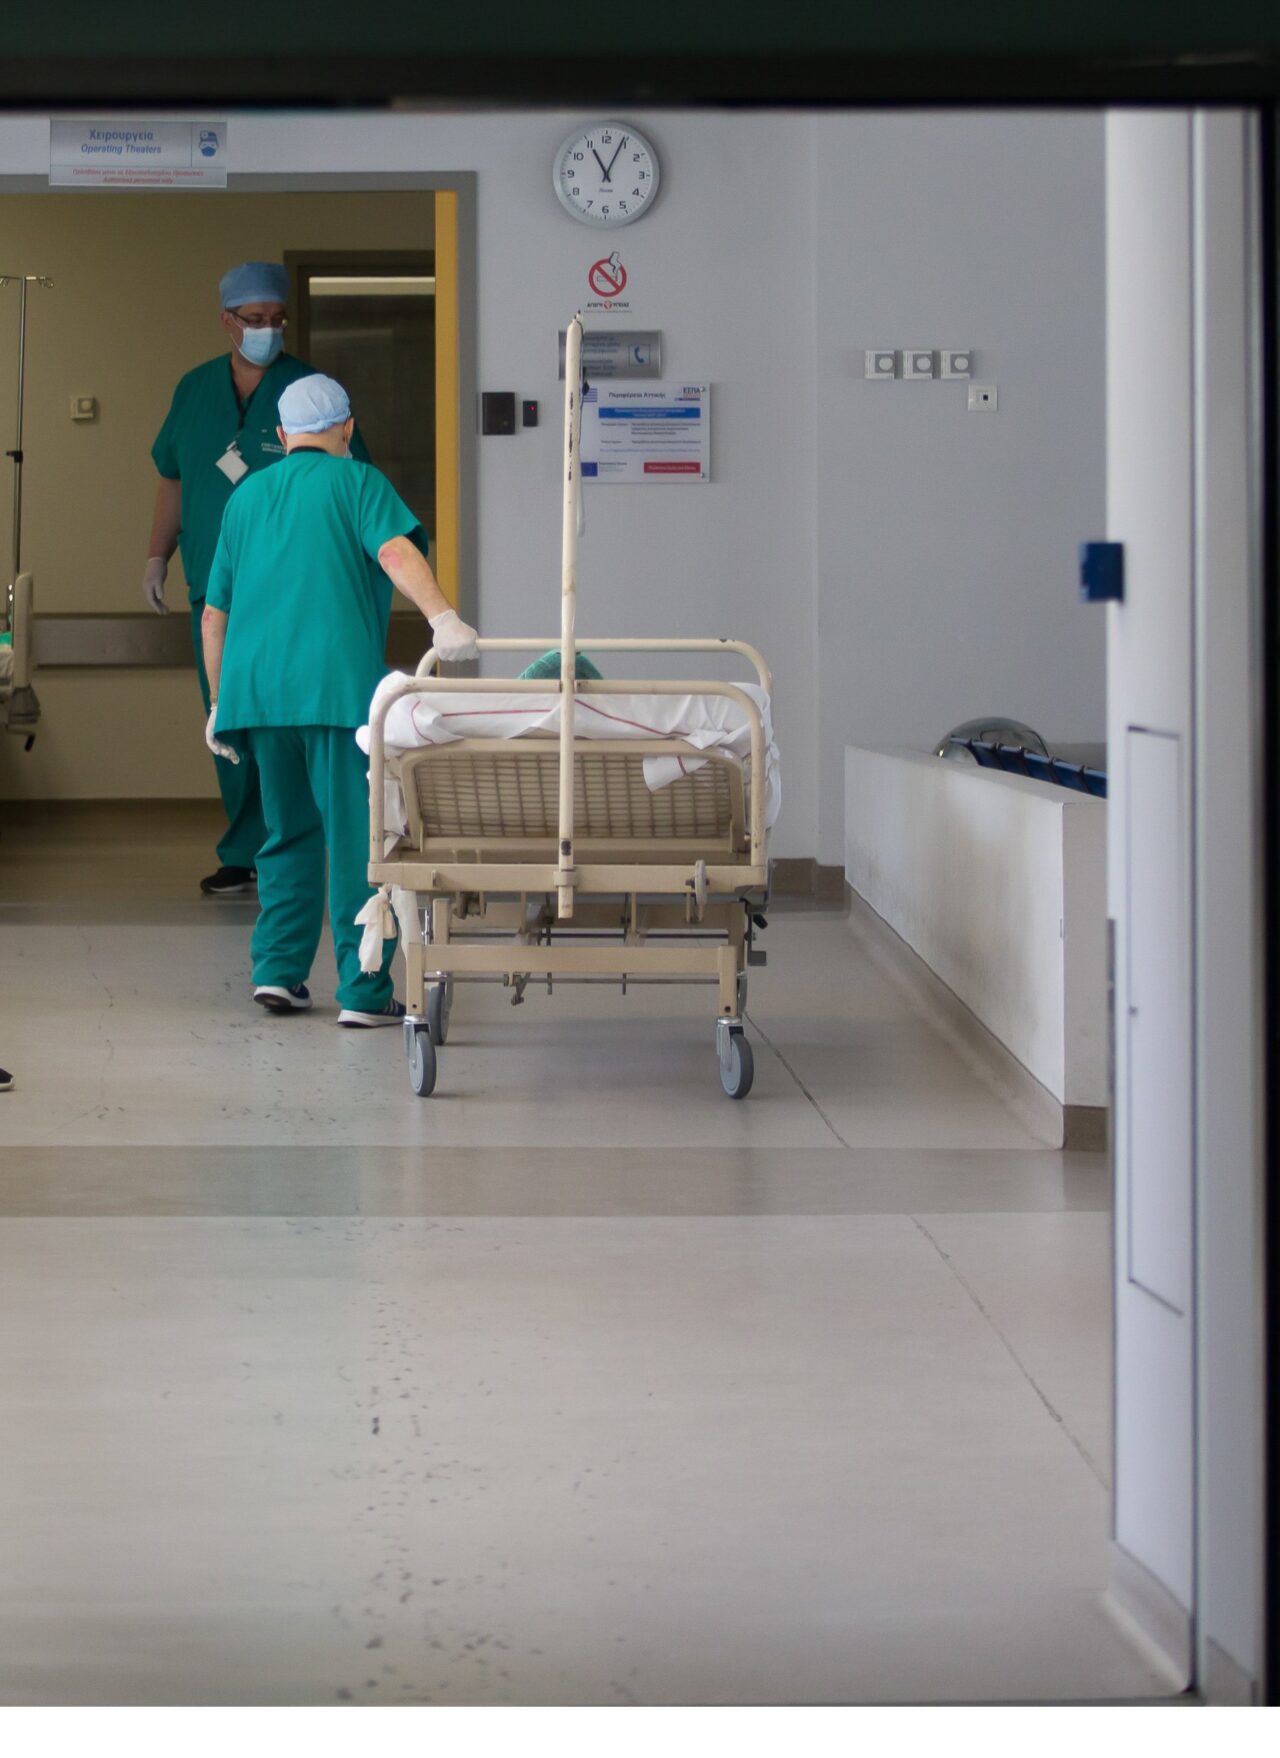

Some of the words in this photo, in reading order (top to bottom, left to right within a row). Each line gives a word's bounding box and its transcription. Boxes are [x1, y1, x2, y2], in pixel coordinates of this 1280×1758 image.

[88, 128, 154, 142] Χειρουργεία
[587, 140, 593, 149] 11
[601, 136, 612, 144] 12
[81, 144, 123, 155] Operating
[126, 144, 162, 154] Theaters
[573, 152, 584, 161] 10
[633, 153, 640, 162] 2
[567, 170, 575, 178] 9
[638, 171, 645, 180] 3
[572, 187, 580, 196] 8
[632, 188, 640, 196] 4
[586, 200, 594, 209] 7
[619, 201, 626, 210] 5
[601, 205, 609, 214] 6
